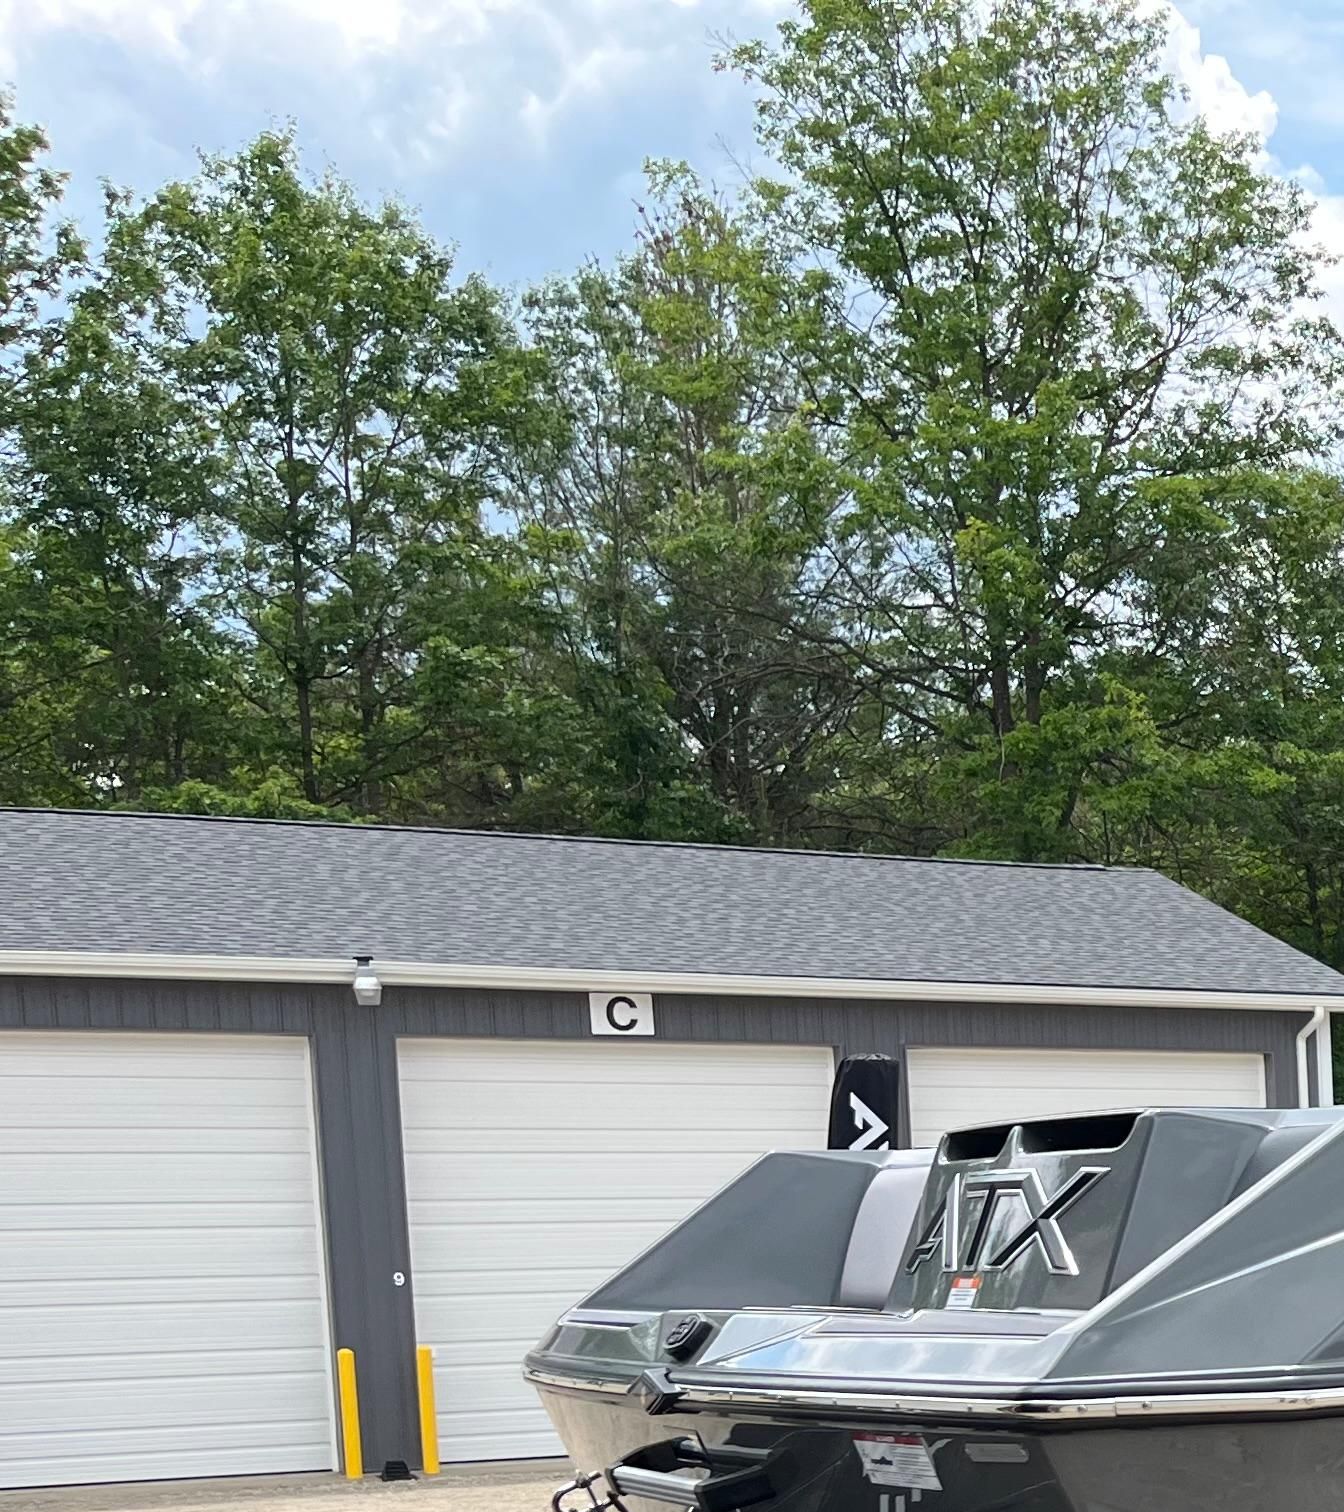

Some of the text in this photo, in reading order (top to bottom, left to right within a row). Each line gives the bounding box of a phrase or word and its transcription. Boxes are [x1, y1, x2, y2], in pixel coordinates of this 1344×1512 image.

[606, 996, 639, 1031] C
[905, 1166, 1112, 1276] ATX
[393, 1271, 405, 1286] 9
